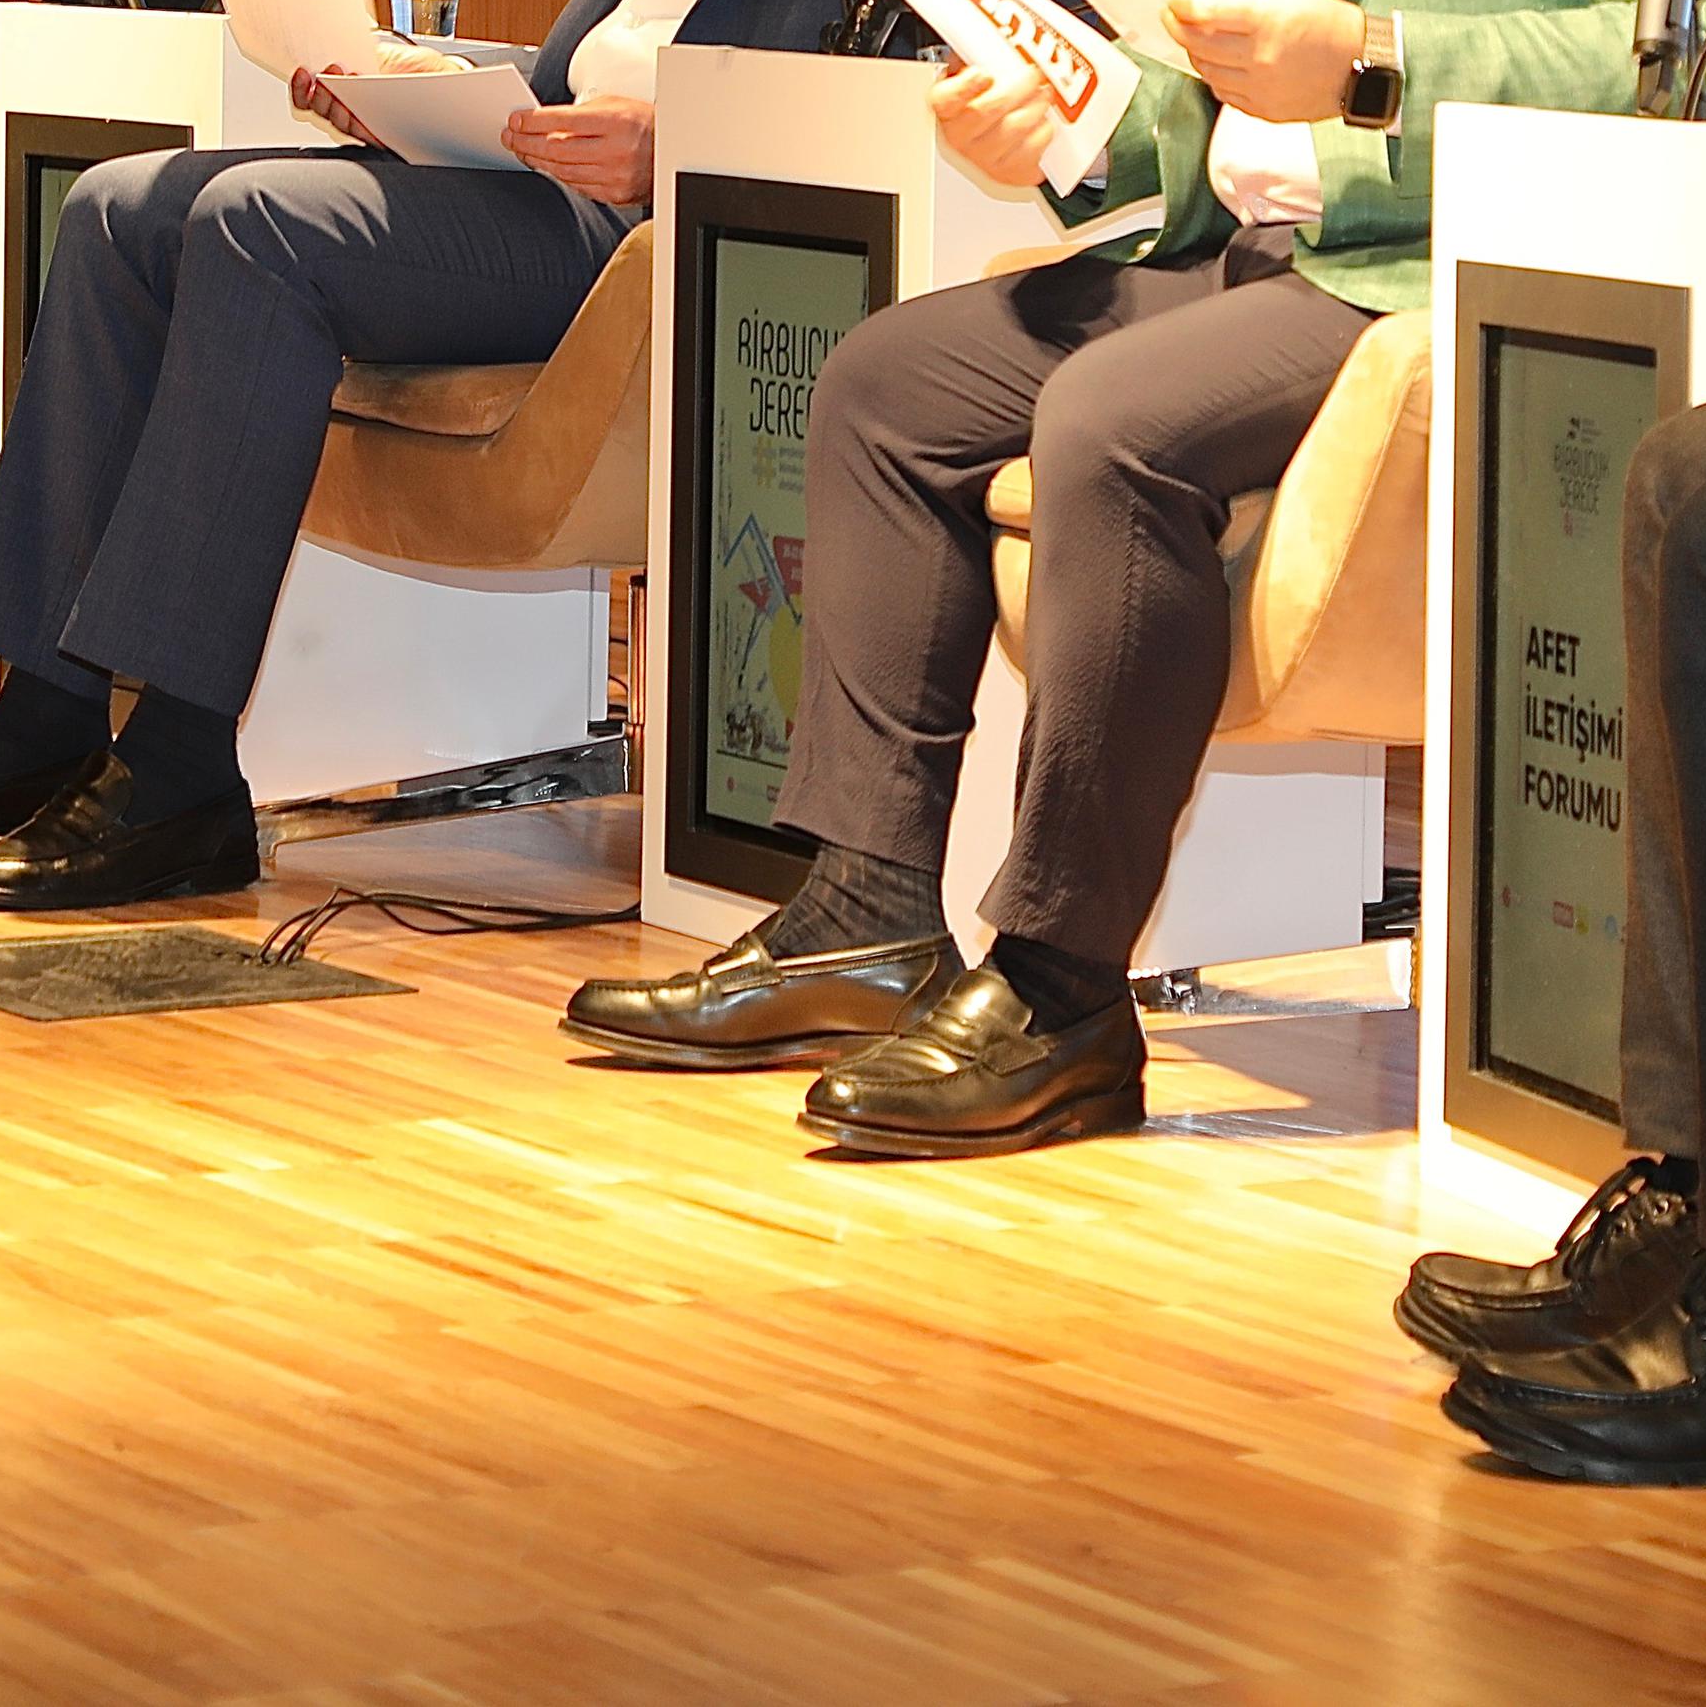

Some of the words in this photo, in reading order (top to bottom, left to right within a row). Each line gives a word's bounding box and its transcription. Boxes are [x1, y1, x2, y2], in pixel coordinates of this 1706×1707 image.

[1526, 626, 1580, 677] AFET
[1526, 682, 1623, 762] İLETİŞİMİ
[1524, 764, 1621, 833] FORUMU
